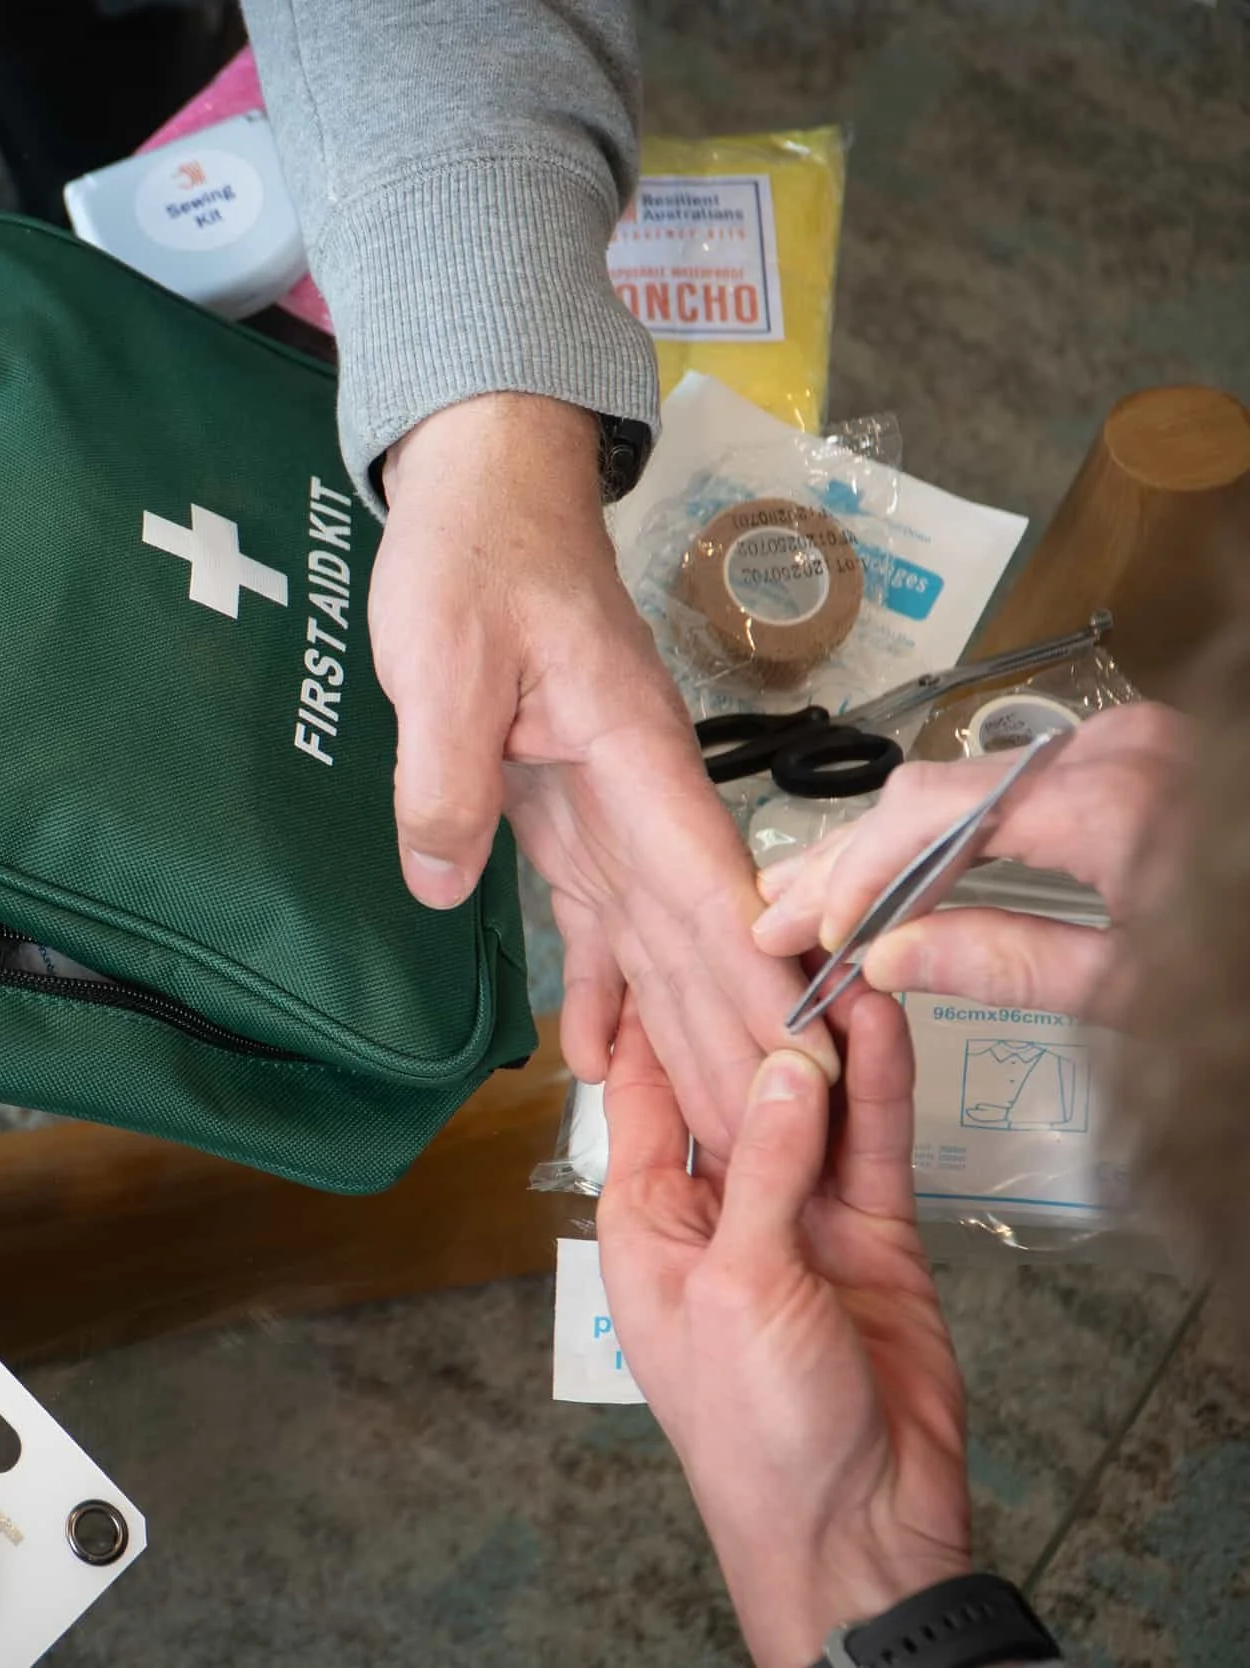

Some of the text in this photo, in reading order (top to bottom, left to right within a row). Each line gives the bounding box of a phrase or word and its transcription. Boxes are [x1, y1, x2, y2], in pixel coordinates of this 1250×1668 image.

[166, 184, 236, 219] Sewing
[642, 193, 720, 206] Resilient
[195, 208, 223, 229] Kit
[642, 209, 744, 221] Australians
[616, 282, 759, 324] ONCHO
[294, 475, 352, 767] FIRST AID KIT
